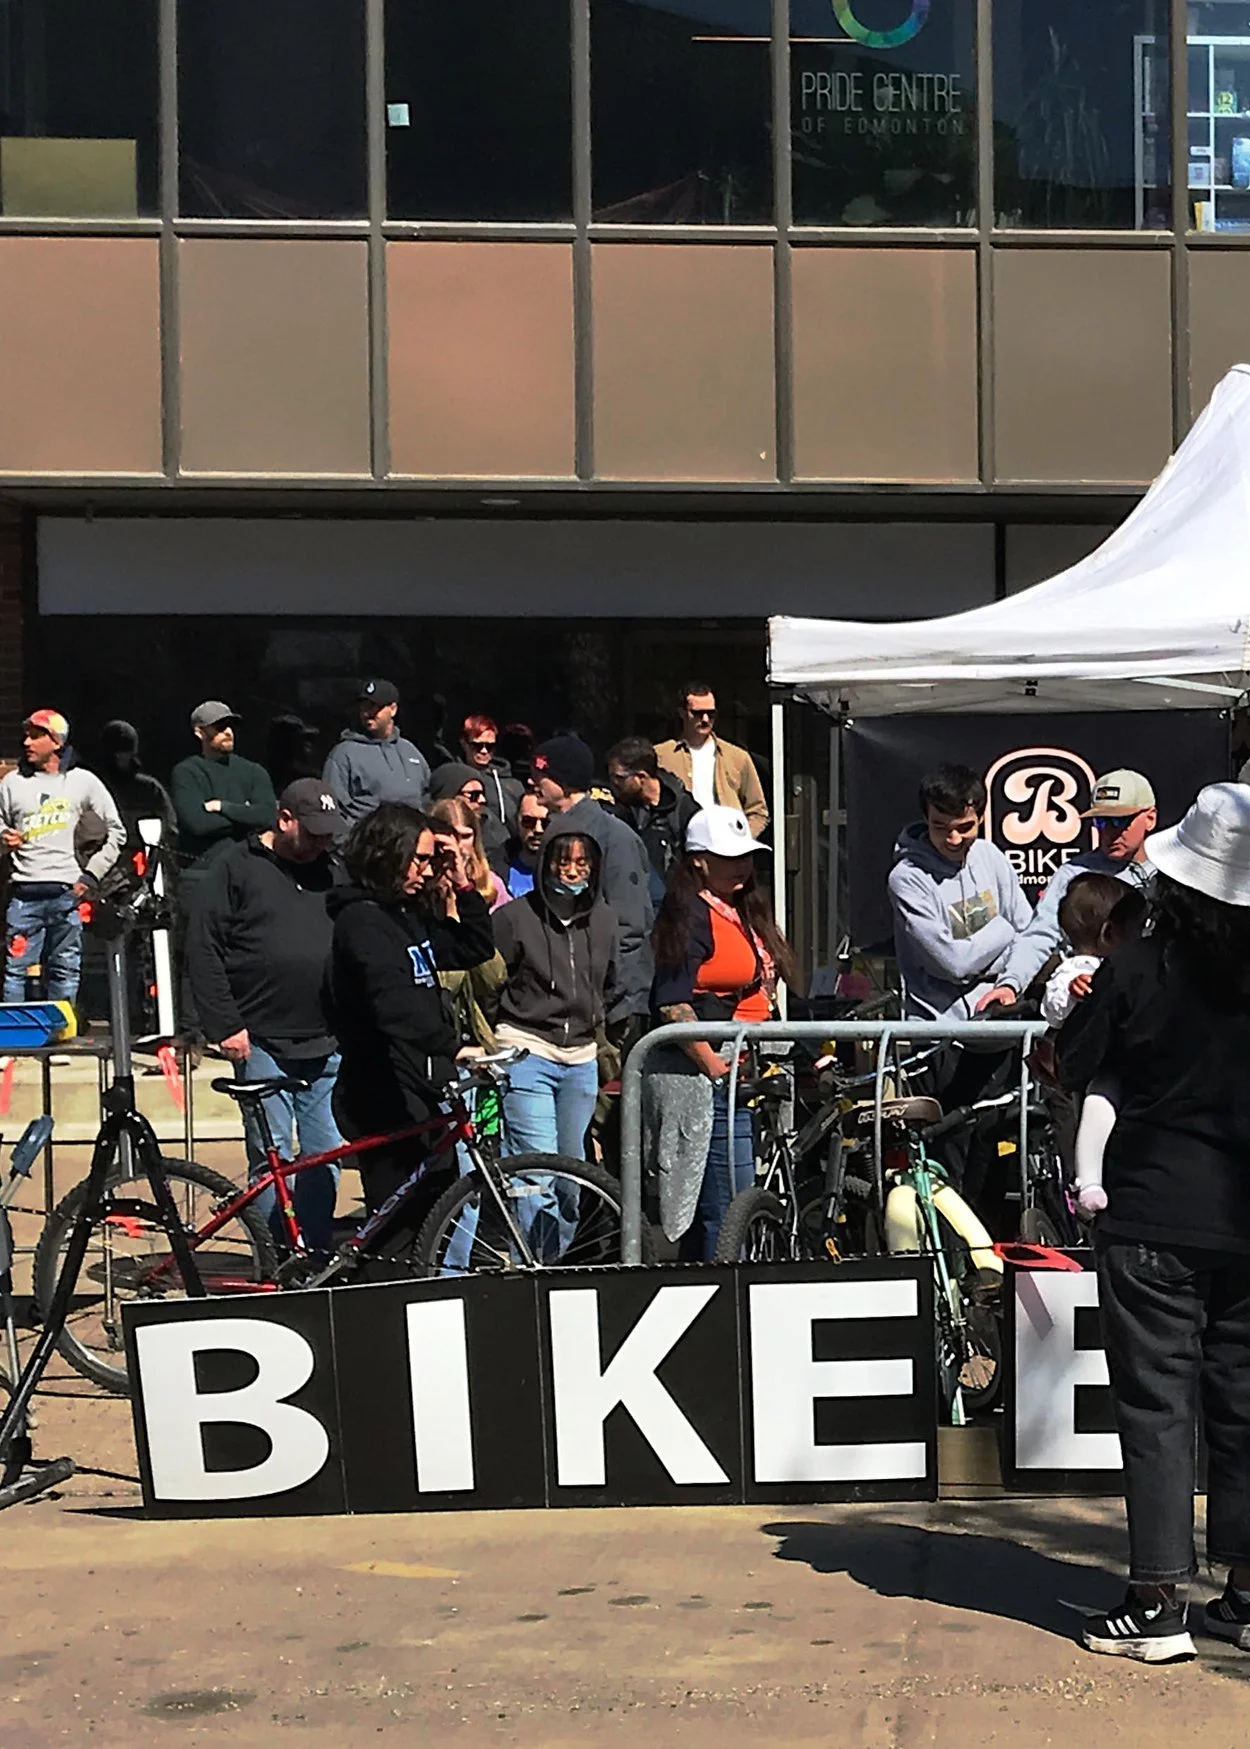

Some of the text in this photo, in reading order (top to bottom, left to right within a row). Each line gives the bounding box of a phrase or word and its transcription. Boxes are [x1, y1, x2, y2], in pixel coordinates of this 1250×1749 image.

[801, 72, 961, 113] PRIDE CENTRE
[802, 117, 964, 135] OF EDMONTON
[135, 1279, 927, 1502] BIKE
